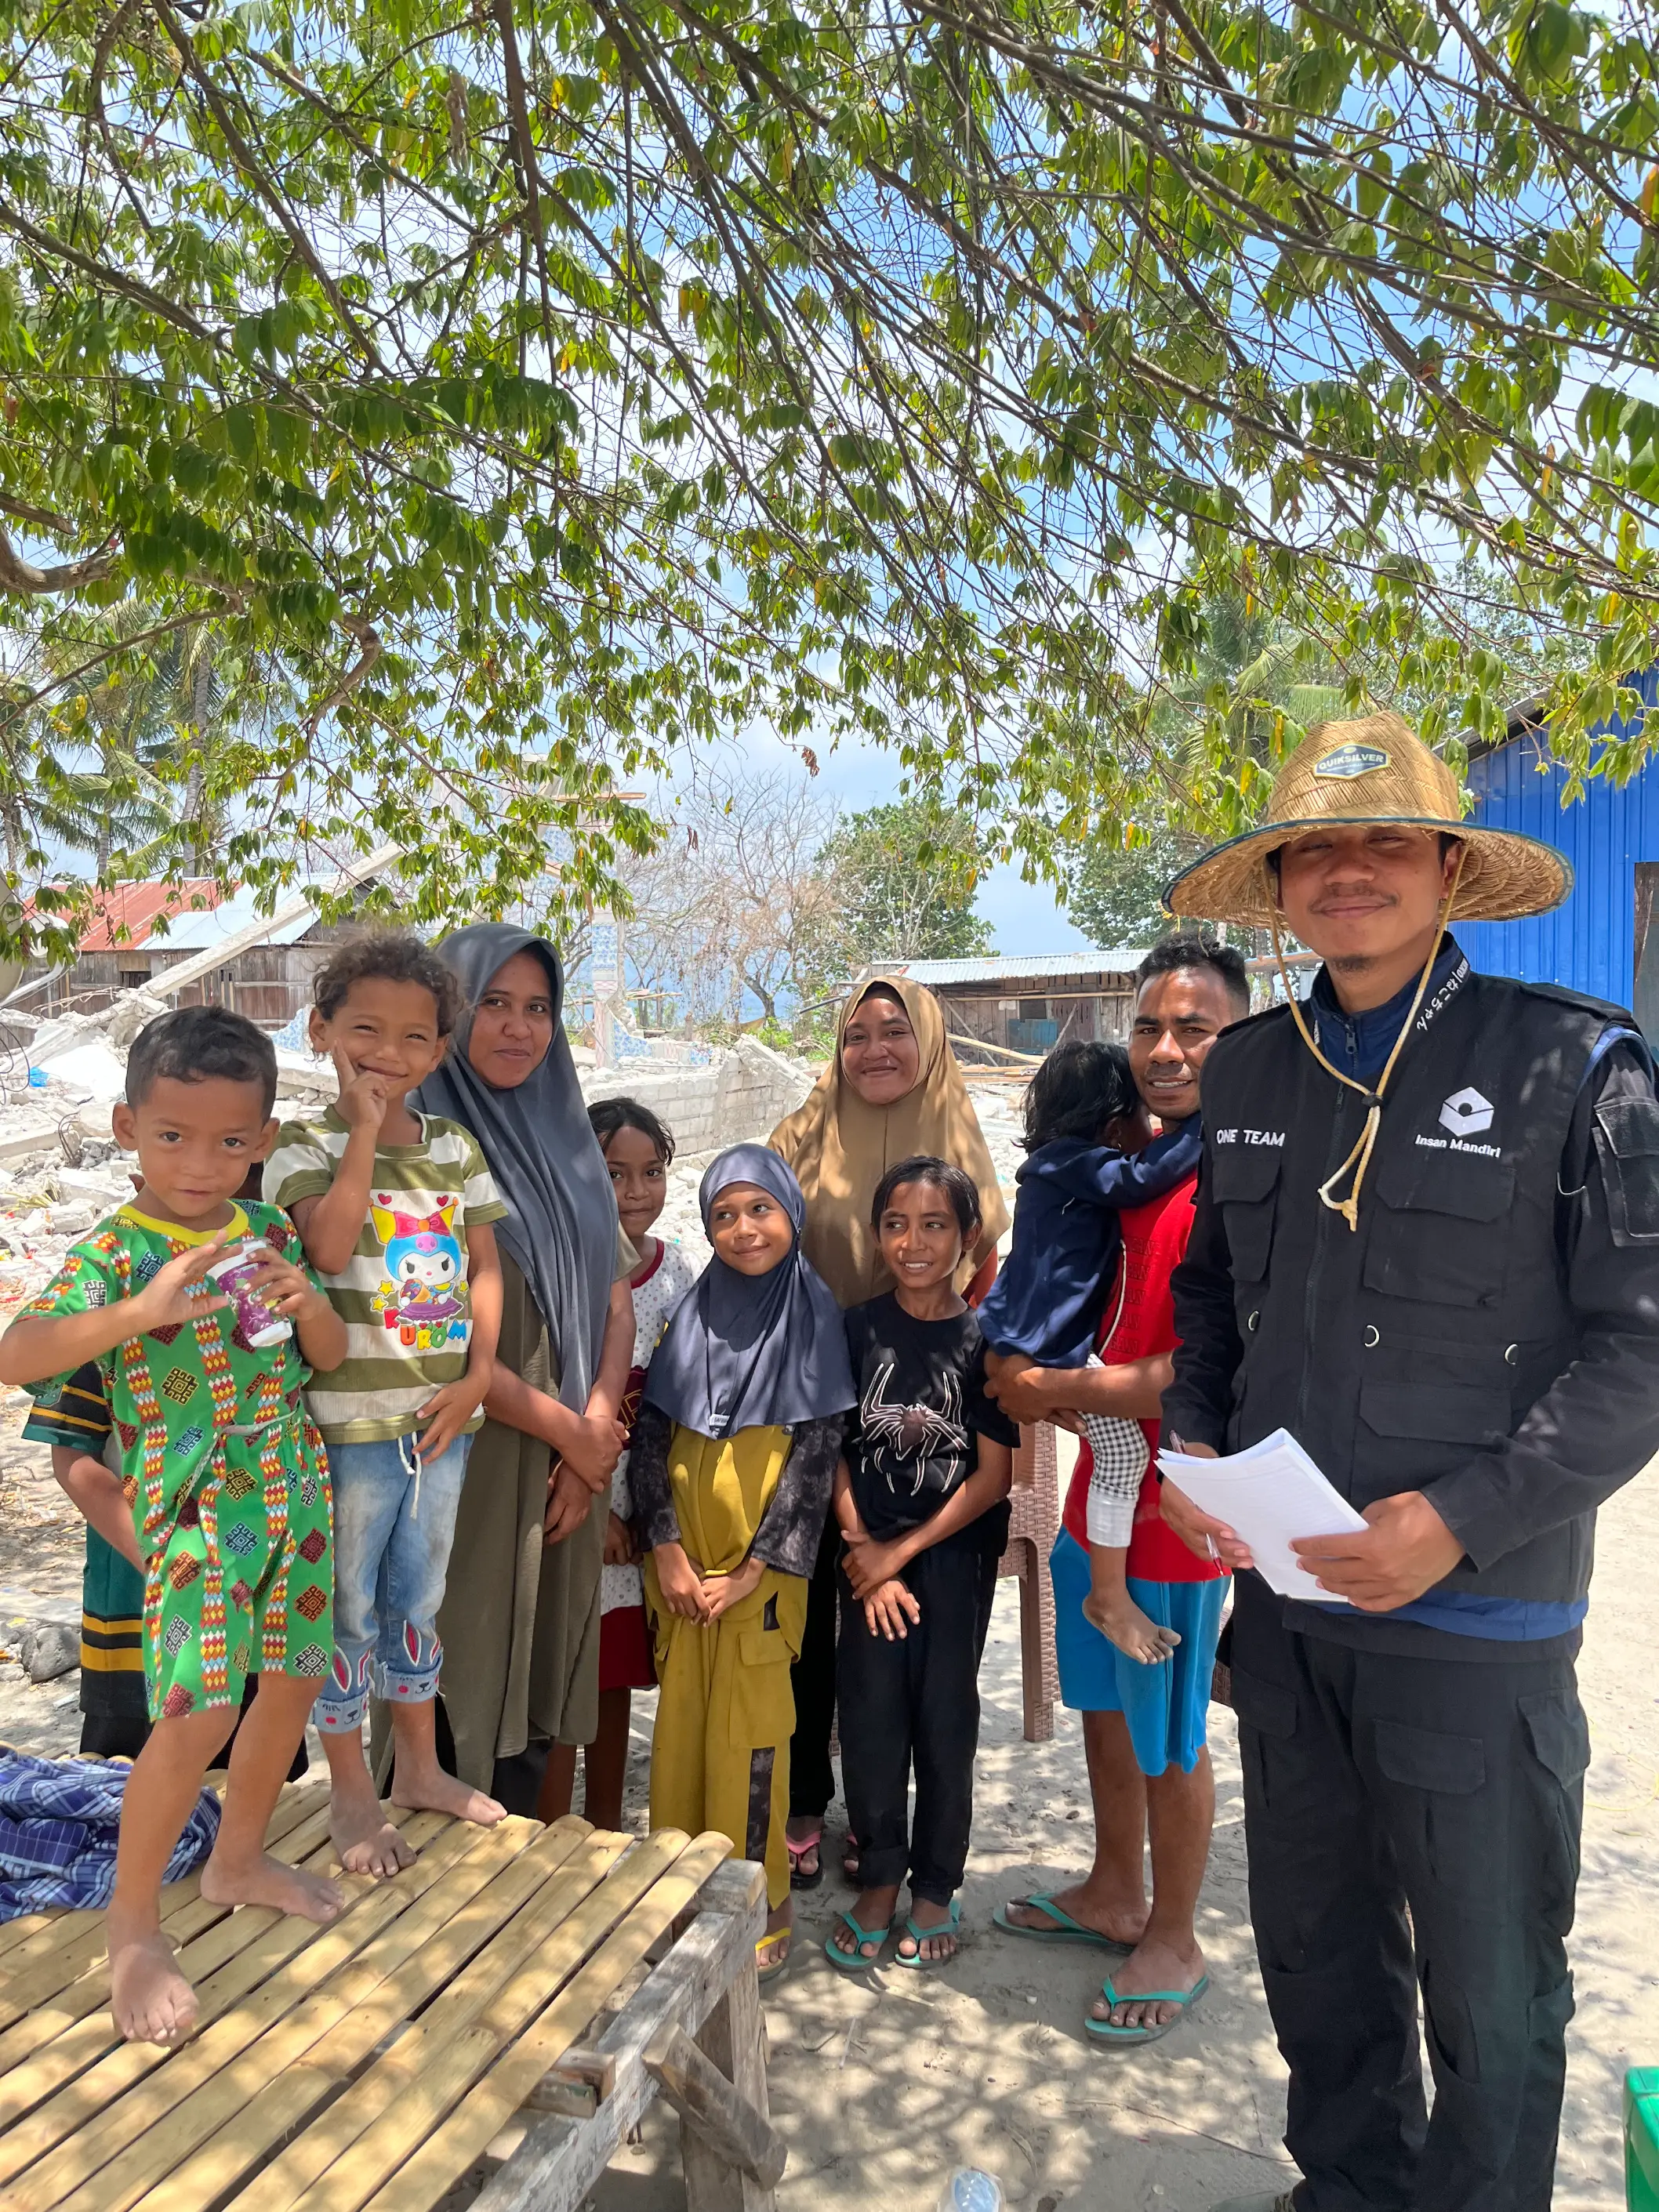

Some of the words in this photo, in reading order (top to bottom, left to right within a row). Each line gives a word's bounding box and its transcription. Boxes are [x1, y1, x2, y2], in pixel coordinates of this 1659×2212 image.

[1319, 753, 1384, 770] QUIKSILVER
[1216, 1129, 1239, 1144] ONE
[1243, 1130, 1286, 1147] TEAM
[1414, 1134, 1447, 1148] Insan
[1449, 1138, 1501, 1158] Mandiri
